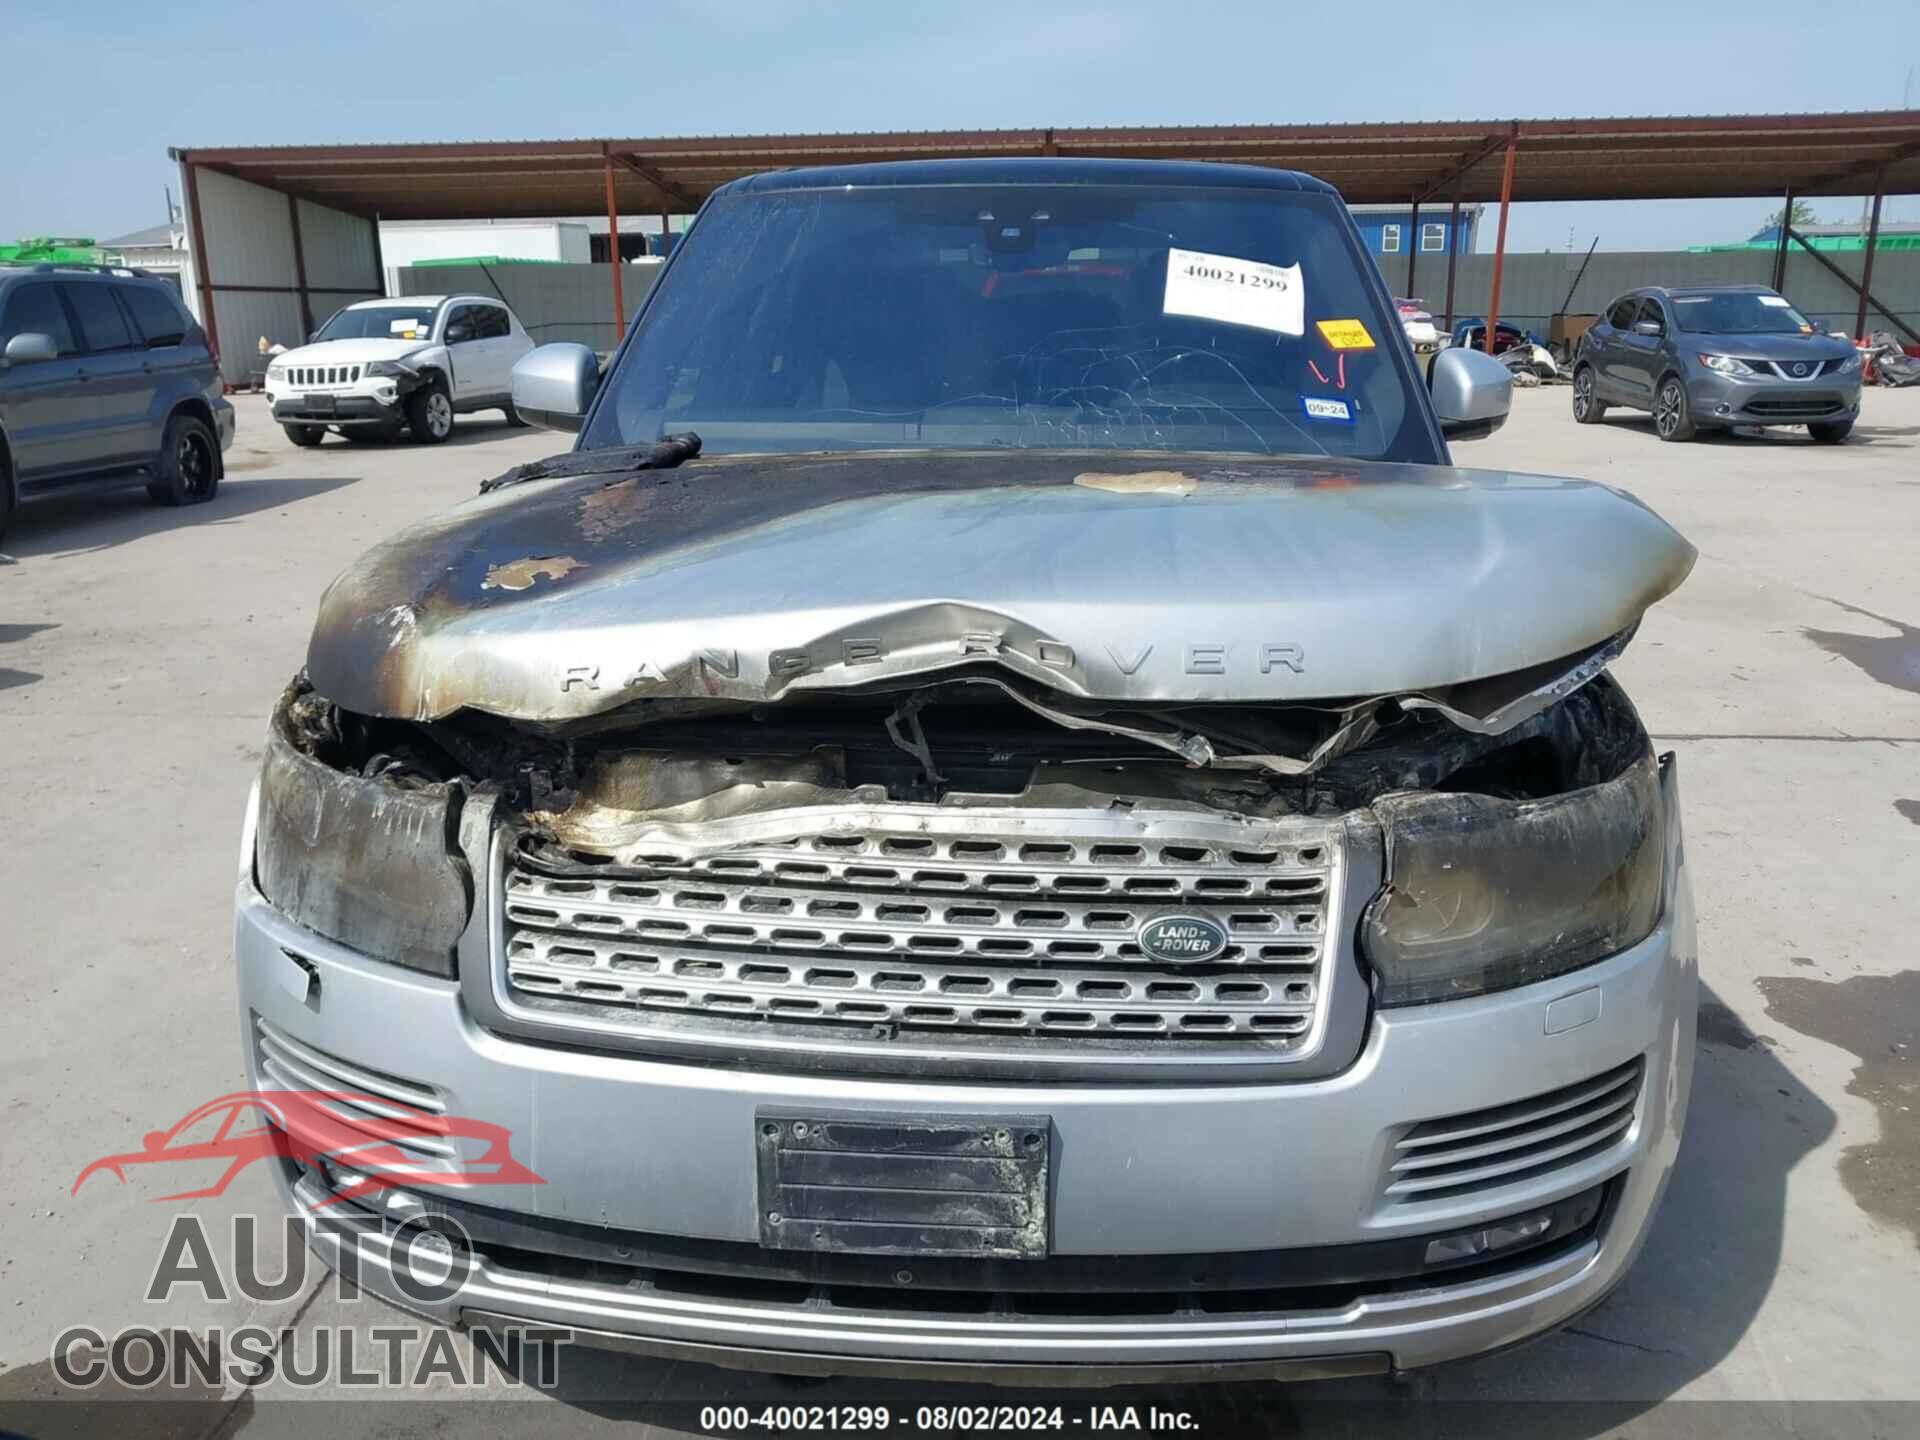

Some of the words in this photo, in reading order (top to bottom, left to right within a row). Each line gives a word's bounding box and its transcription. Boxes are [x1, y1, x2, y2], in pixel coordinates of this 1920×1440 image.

[1183, 264, 1289, 292] 40021299
[1308, 403, 1347, 414] 09-24
[957, 631, 1305, 675] ROVER
